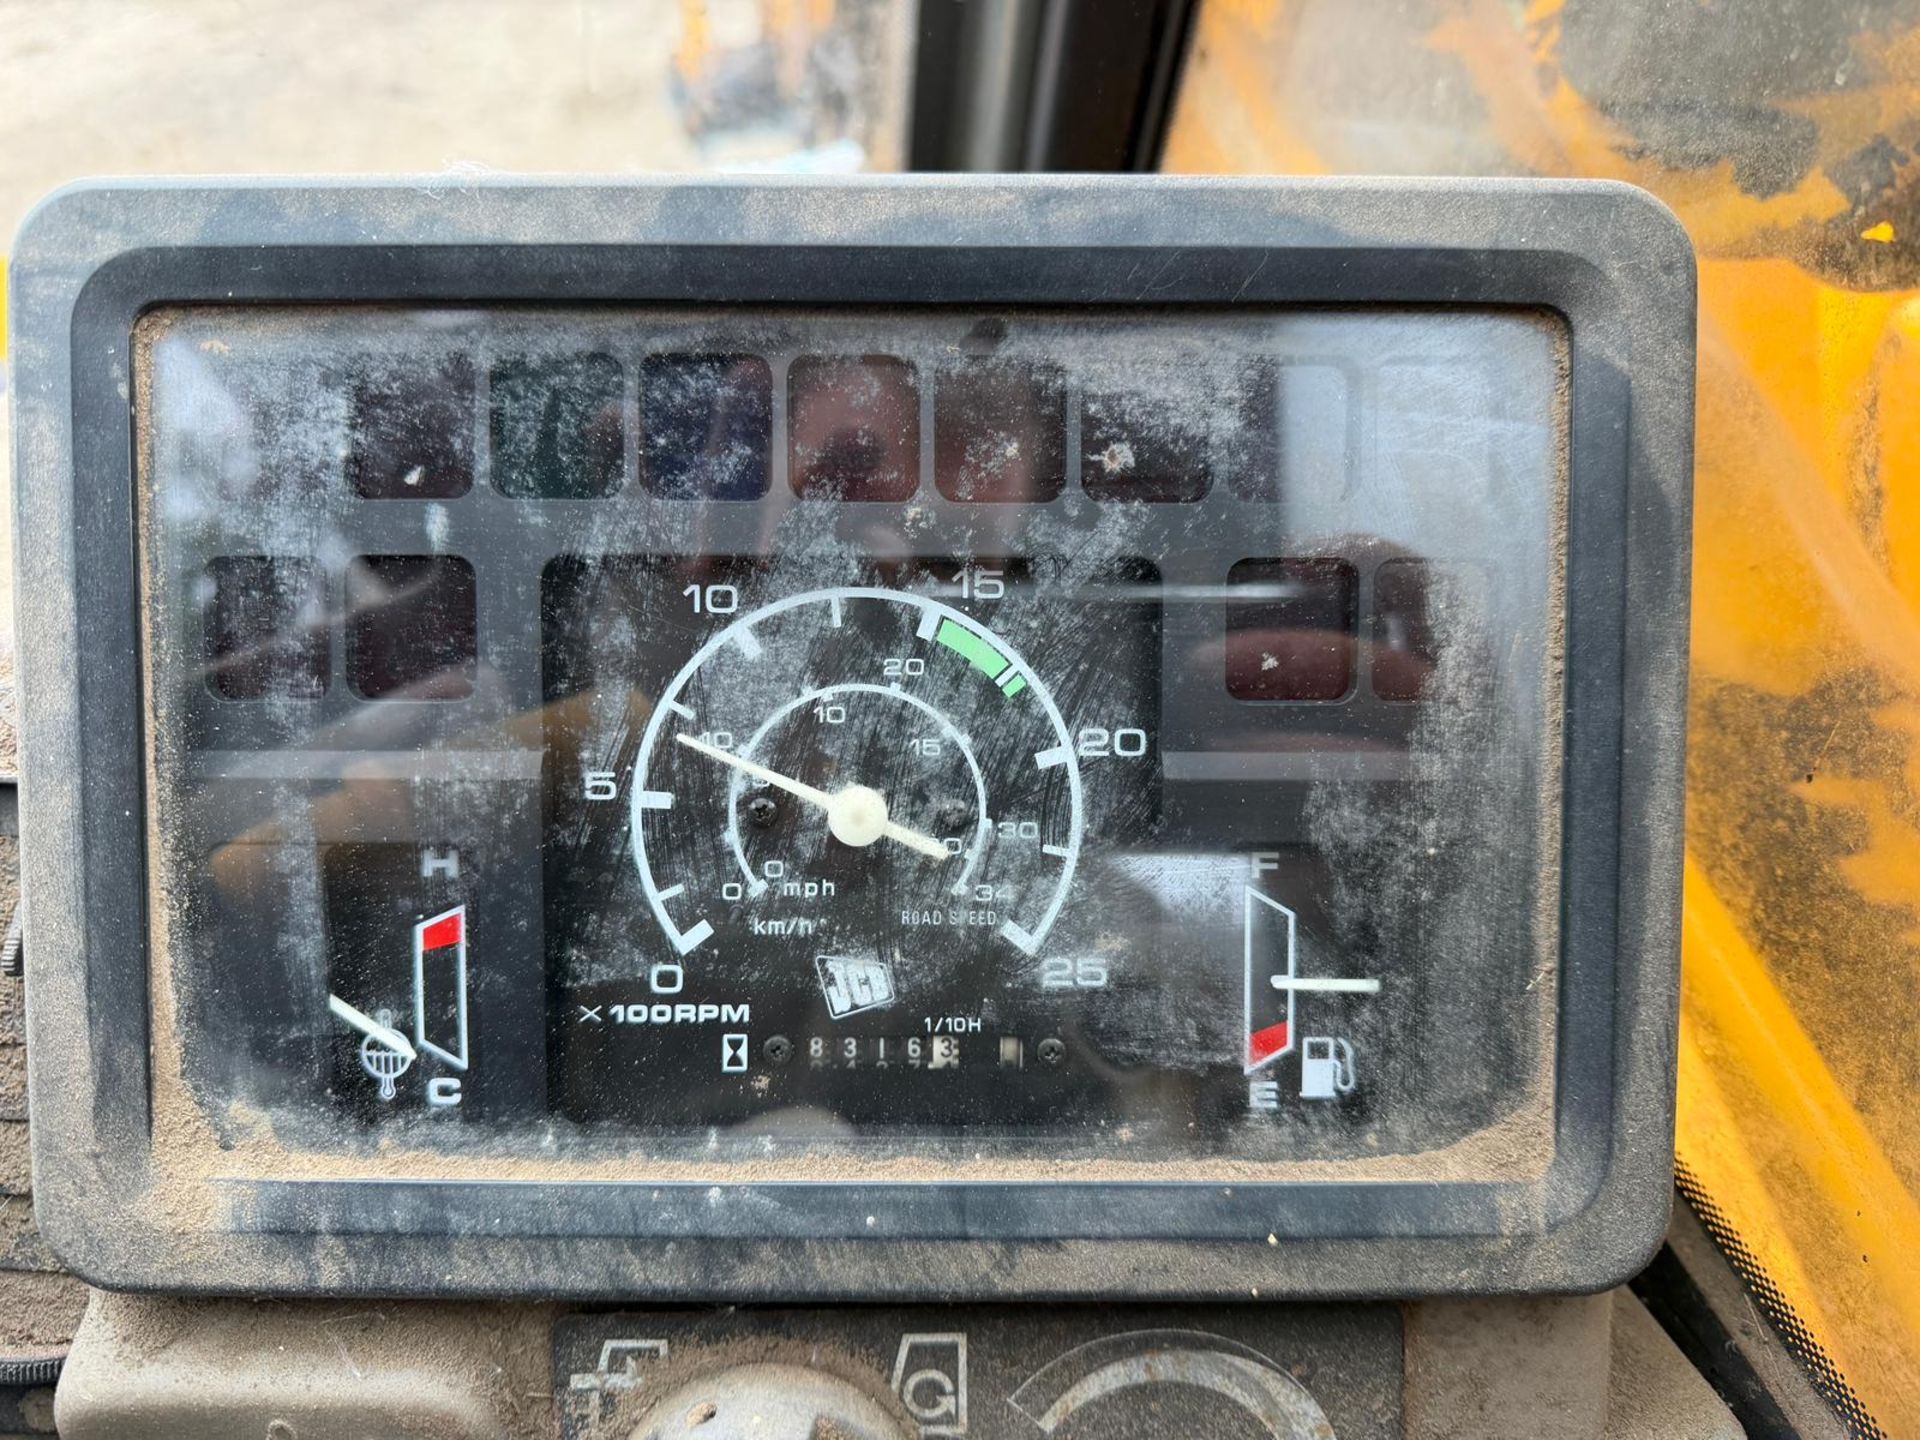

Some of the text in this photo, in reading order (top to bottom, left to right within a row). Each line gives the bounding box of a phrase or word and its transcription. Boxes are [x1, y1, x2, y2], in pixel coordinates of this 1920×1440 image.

[682, 584, 739, 613] 10
[952, 570, 1006, 600] 15
[883, 658, 925, 676] 20
[813, 706, 846, 724] 10
[909, 739, 941, 756] 15
[1079, 728, 1146, 757] 20
[584, 771, 617, 801] 5
[997, 822, 1038, 839] 30
[421, 850, 459, 878] H
[764, 860, 784, 878] 0
[1251, 851, 1280, 879] F
[722, 883, 742, 900] 0
[783, 879, 836, 898] mph
[754, 917, 813, 936] km/h
[901, 910, 942, 926] ROAD
[650, 964, 684, 994] 0
[825, 959, 891, 1014] JCB
[1041, 959, 1109, 988] 25
[609, 1003, 750, 1024] 100RPM
[427, 1077, 463, 1104] C
[1249, 1081, 1279, 1108] E
